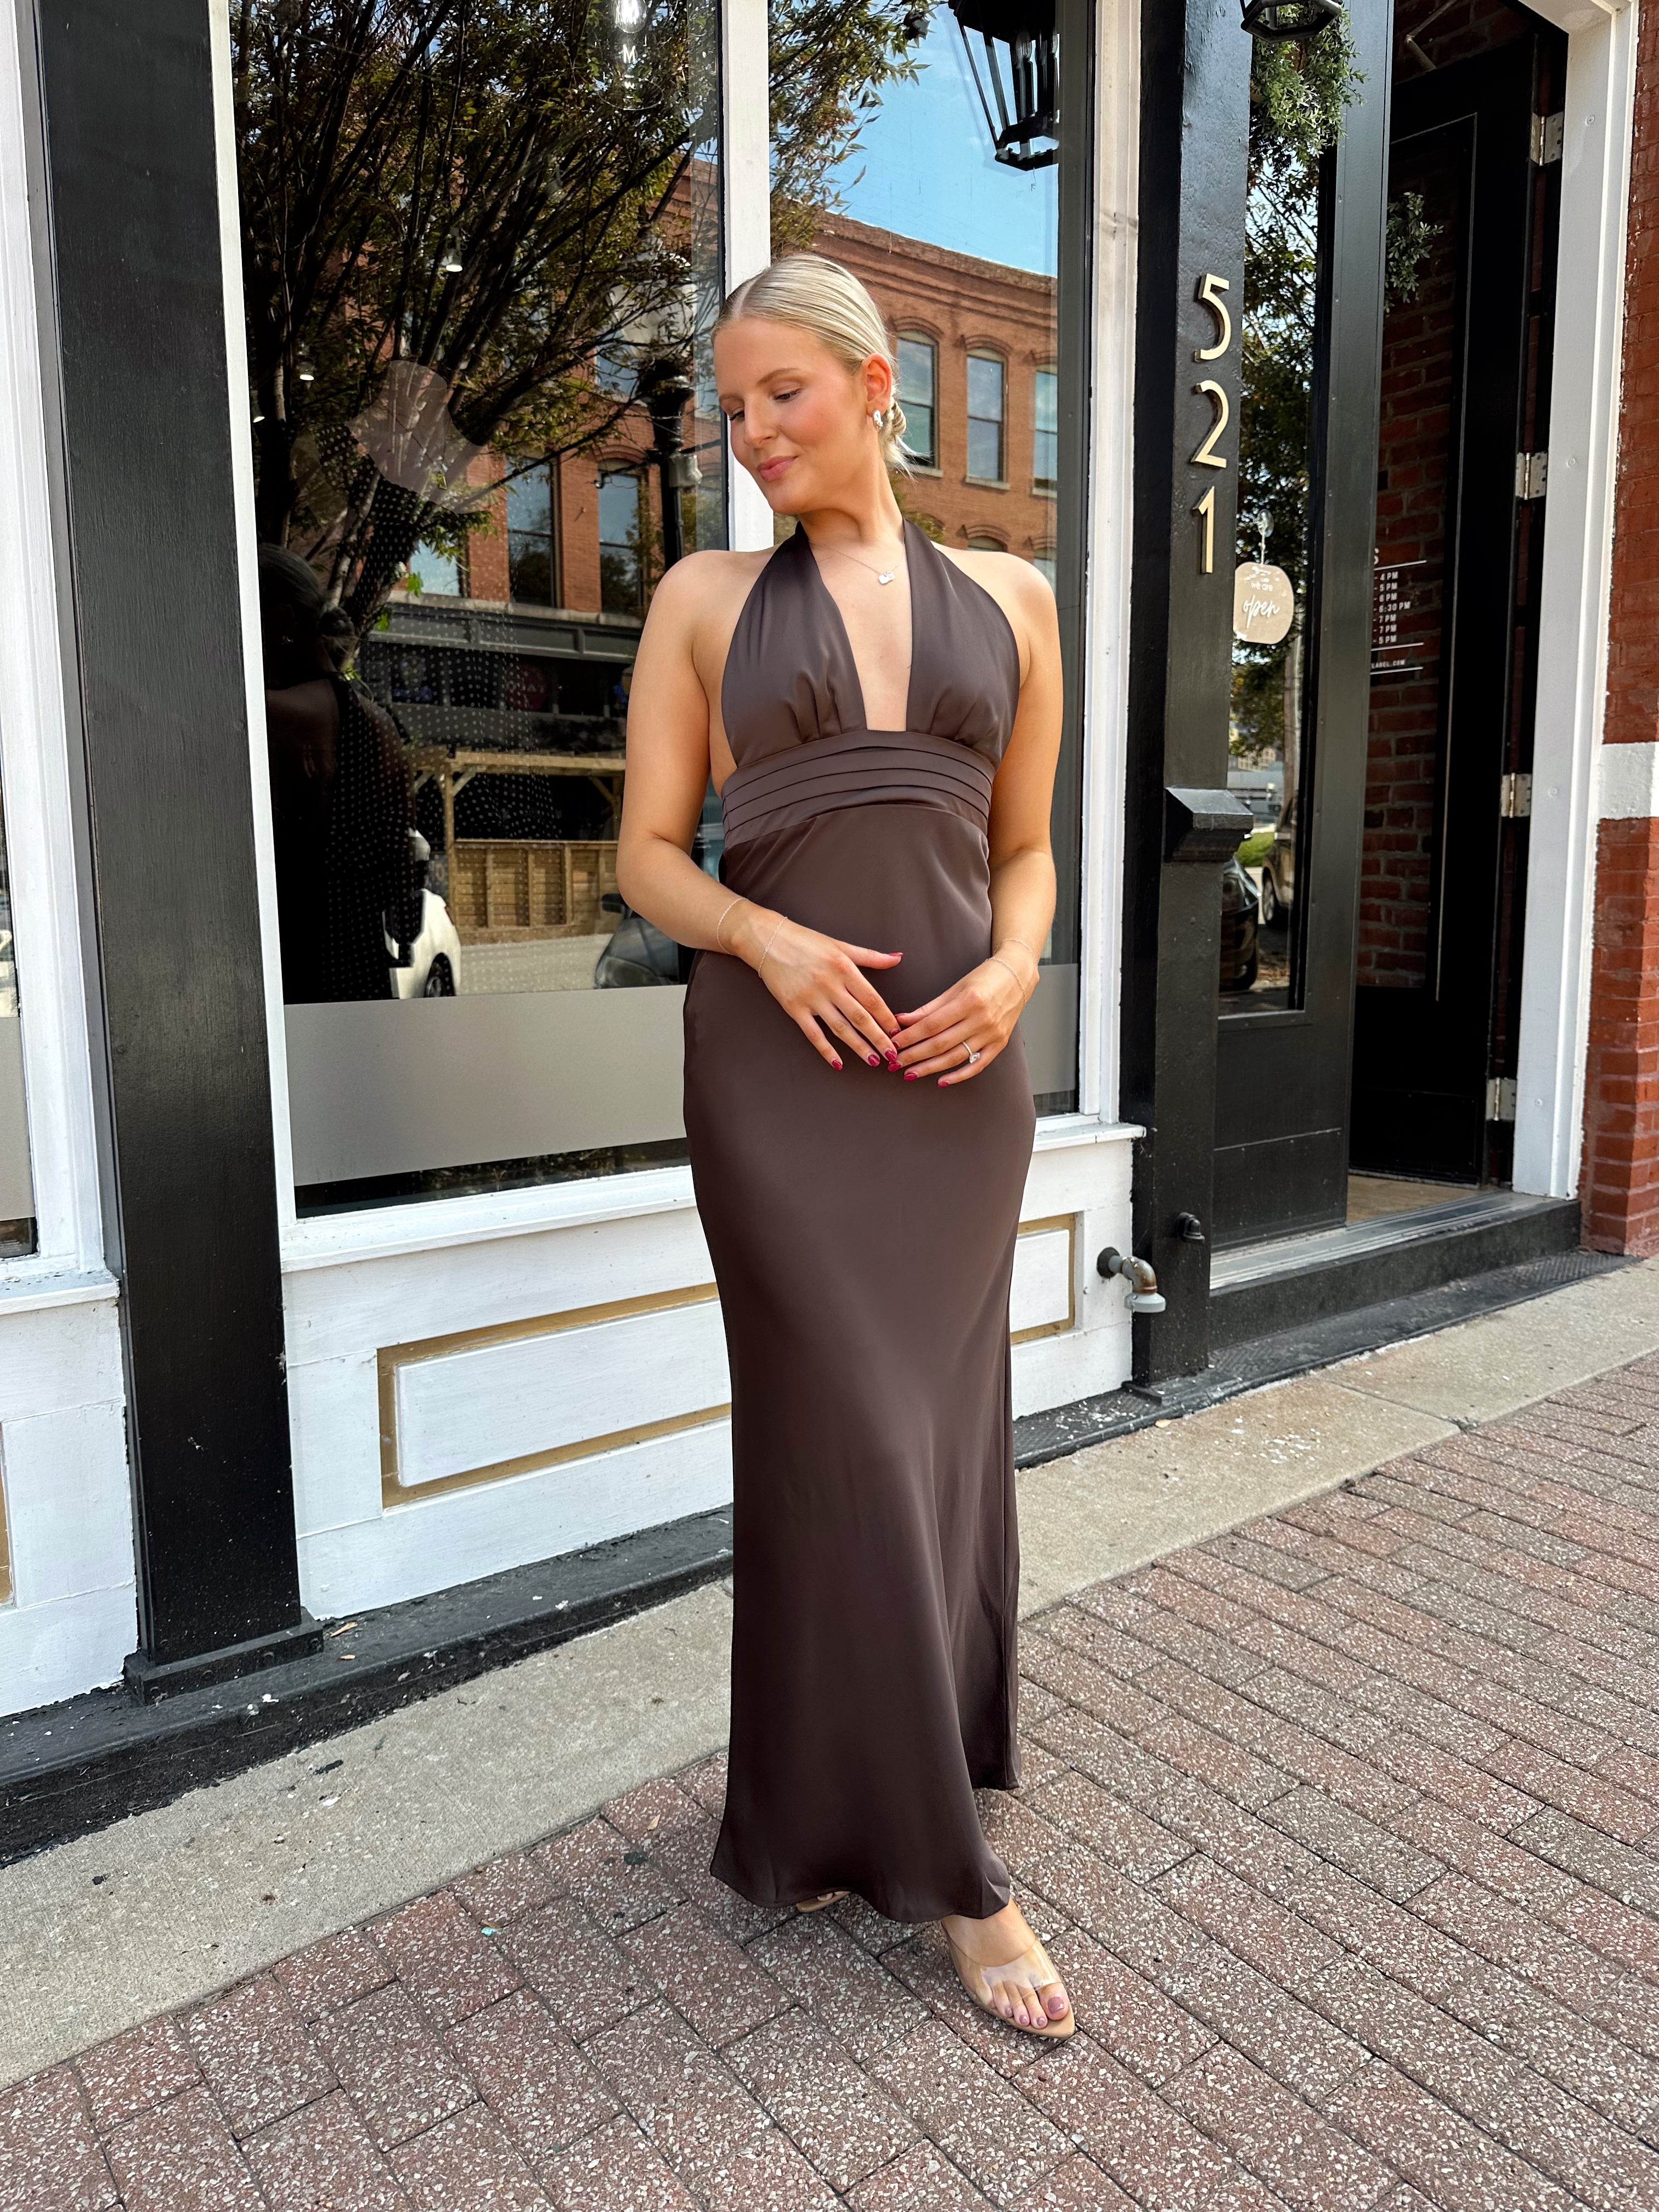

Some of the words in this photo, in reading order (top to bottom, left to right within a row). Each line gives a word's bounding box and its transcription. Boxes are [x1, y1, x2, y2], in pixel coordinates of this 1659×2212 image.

[1192, 273, 1232, 574] 521
[1387, 571, 1398, 580] PM
[1379, 583, 1385, 592] 5
[1386, 582, 1398, 591] PM
[1386, 592, 1397, 601] PM
[1399, 601, 1411, 611] PM
[1243, 594, 1280, 629] open
[1379, 615, 1384, 623] 7
[1385, 613, 1397, 623] PM
[1379, 625, 1384, 634] 7
[1385, 624, 1397, 633] PM
[1385, 635, 1397, 644] PM
